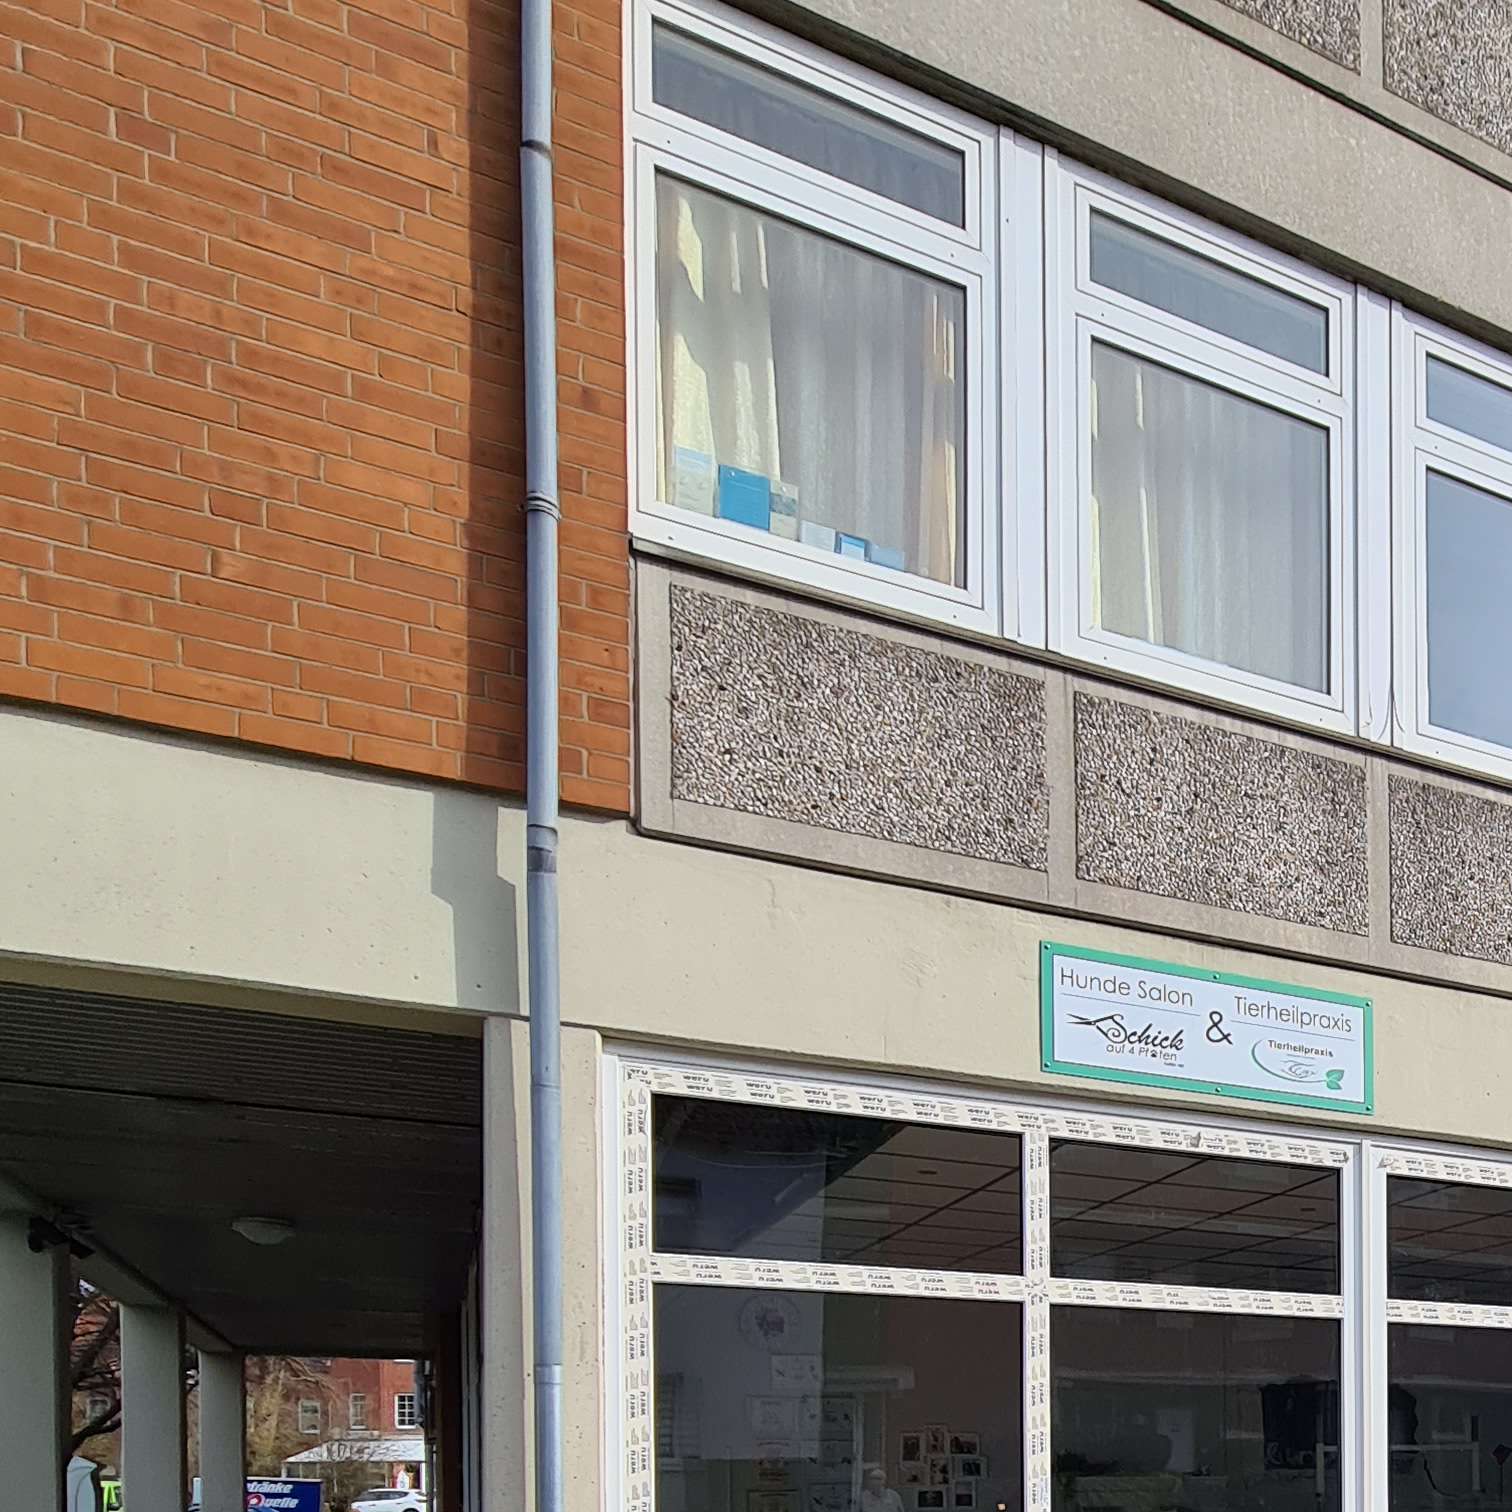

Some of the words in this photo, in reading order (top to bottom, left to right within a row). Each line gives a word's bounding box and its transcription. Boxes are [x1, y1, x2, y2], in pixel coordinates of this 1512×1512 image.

[1060, 967, 1131, 996] Hunde
[1138, 980, 1194, 1008] Salon
[1205, 1011, 1233, 1045] &
[1234, 995, 1352, 1033] Tierheilpraxis
[1094, 1013, 1185, 1052] Schick
[1106, 1043, 1126, 1055] auf
[1128, 1046, 1136, 1056] 4
[1267, 1039, 1334, 1058] Tierheilpraxis
[247, 1481, 294, 1494] tränke
